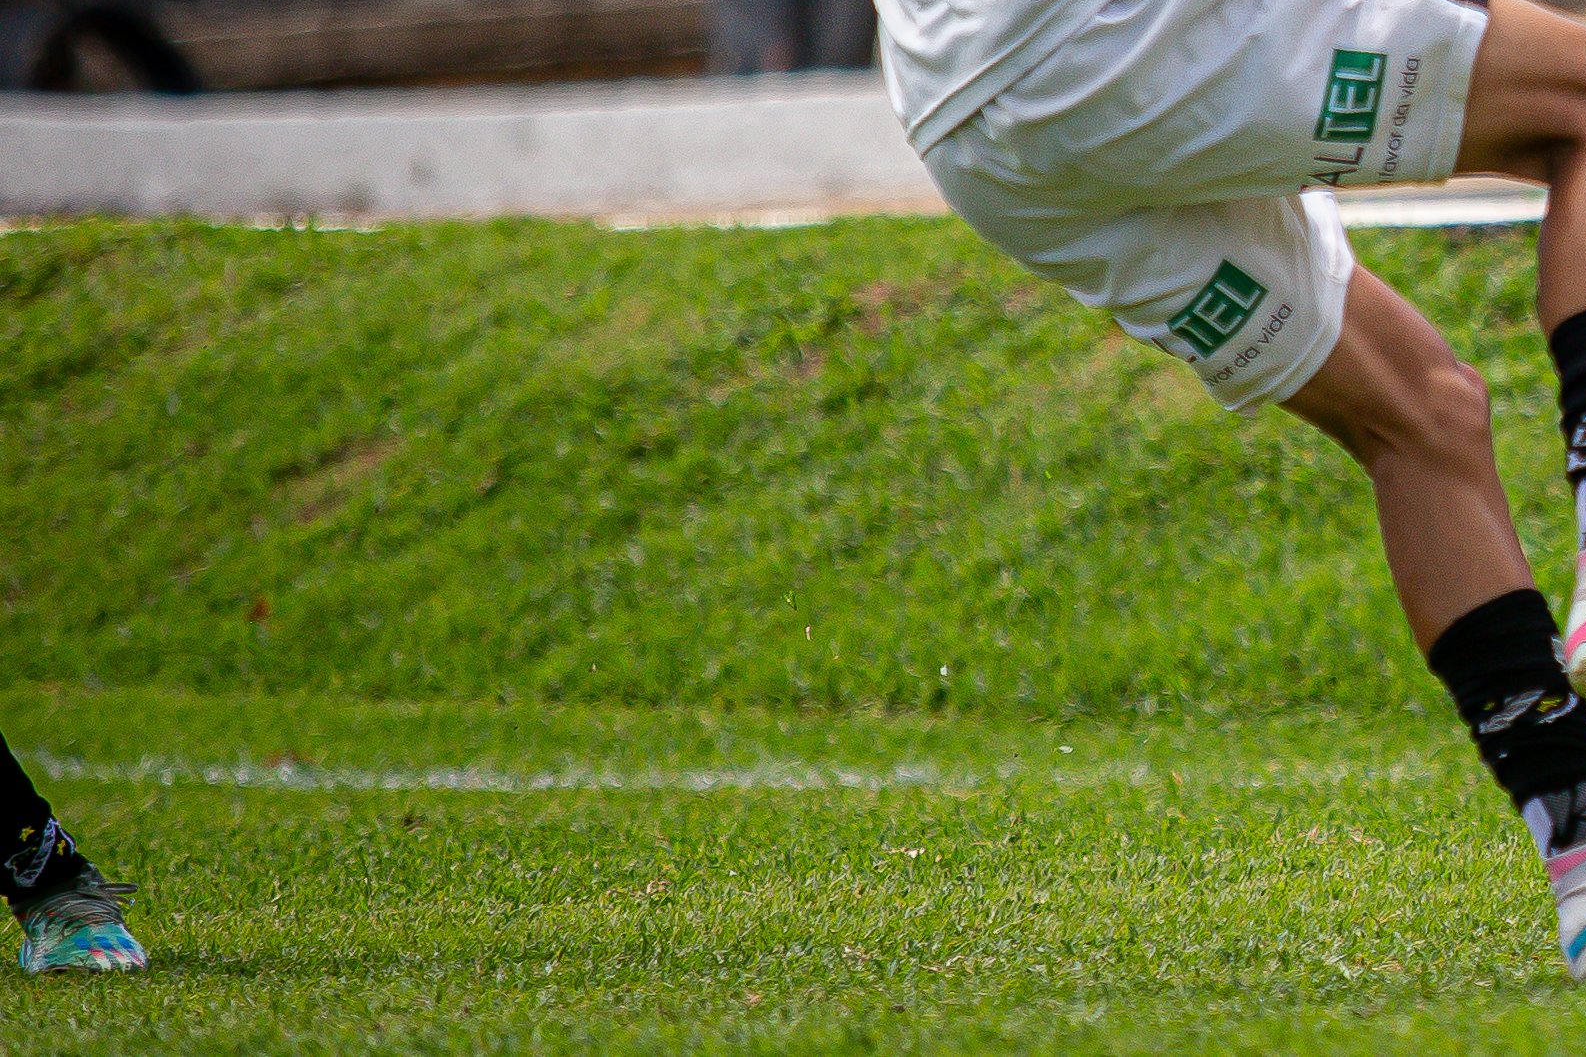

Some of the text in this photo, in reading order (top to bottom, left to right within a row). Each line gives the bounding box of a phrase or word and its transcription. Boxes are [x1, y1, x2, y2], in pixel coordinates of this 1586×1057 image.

[1399, 55, 1421, 99] vida
[1393, 103, 1411, 127] da
[1233, 346, 1261, 368] da
[1257, 303, 1294, 345] vida
